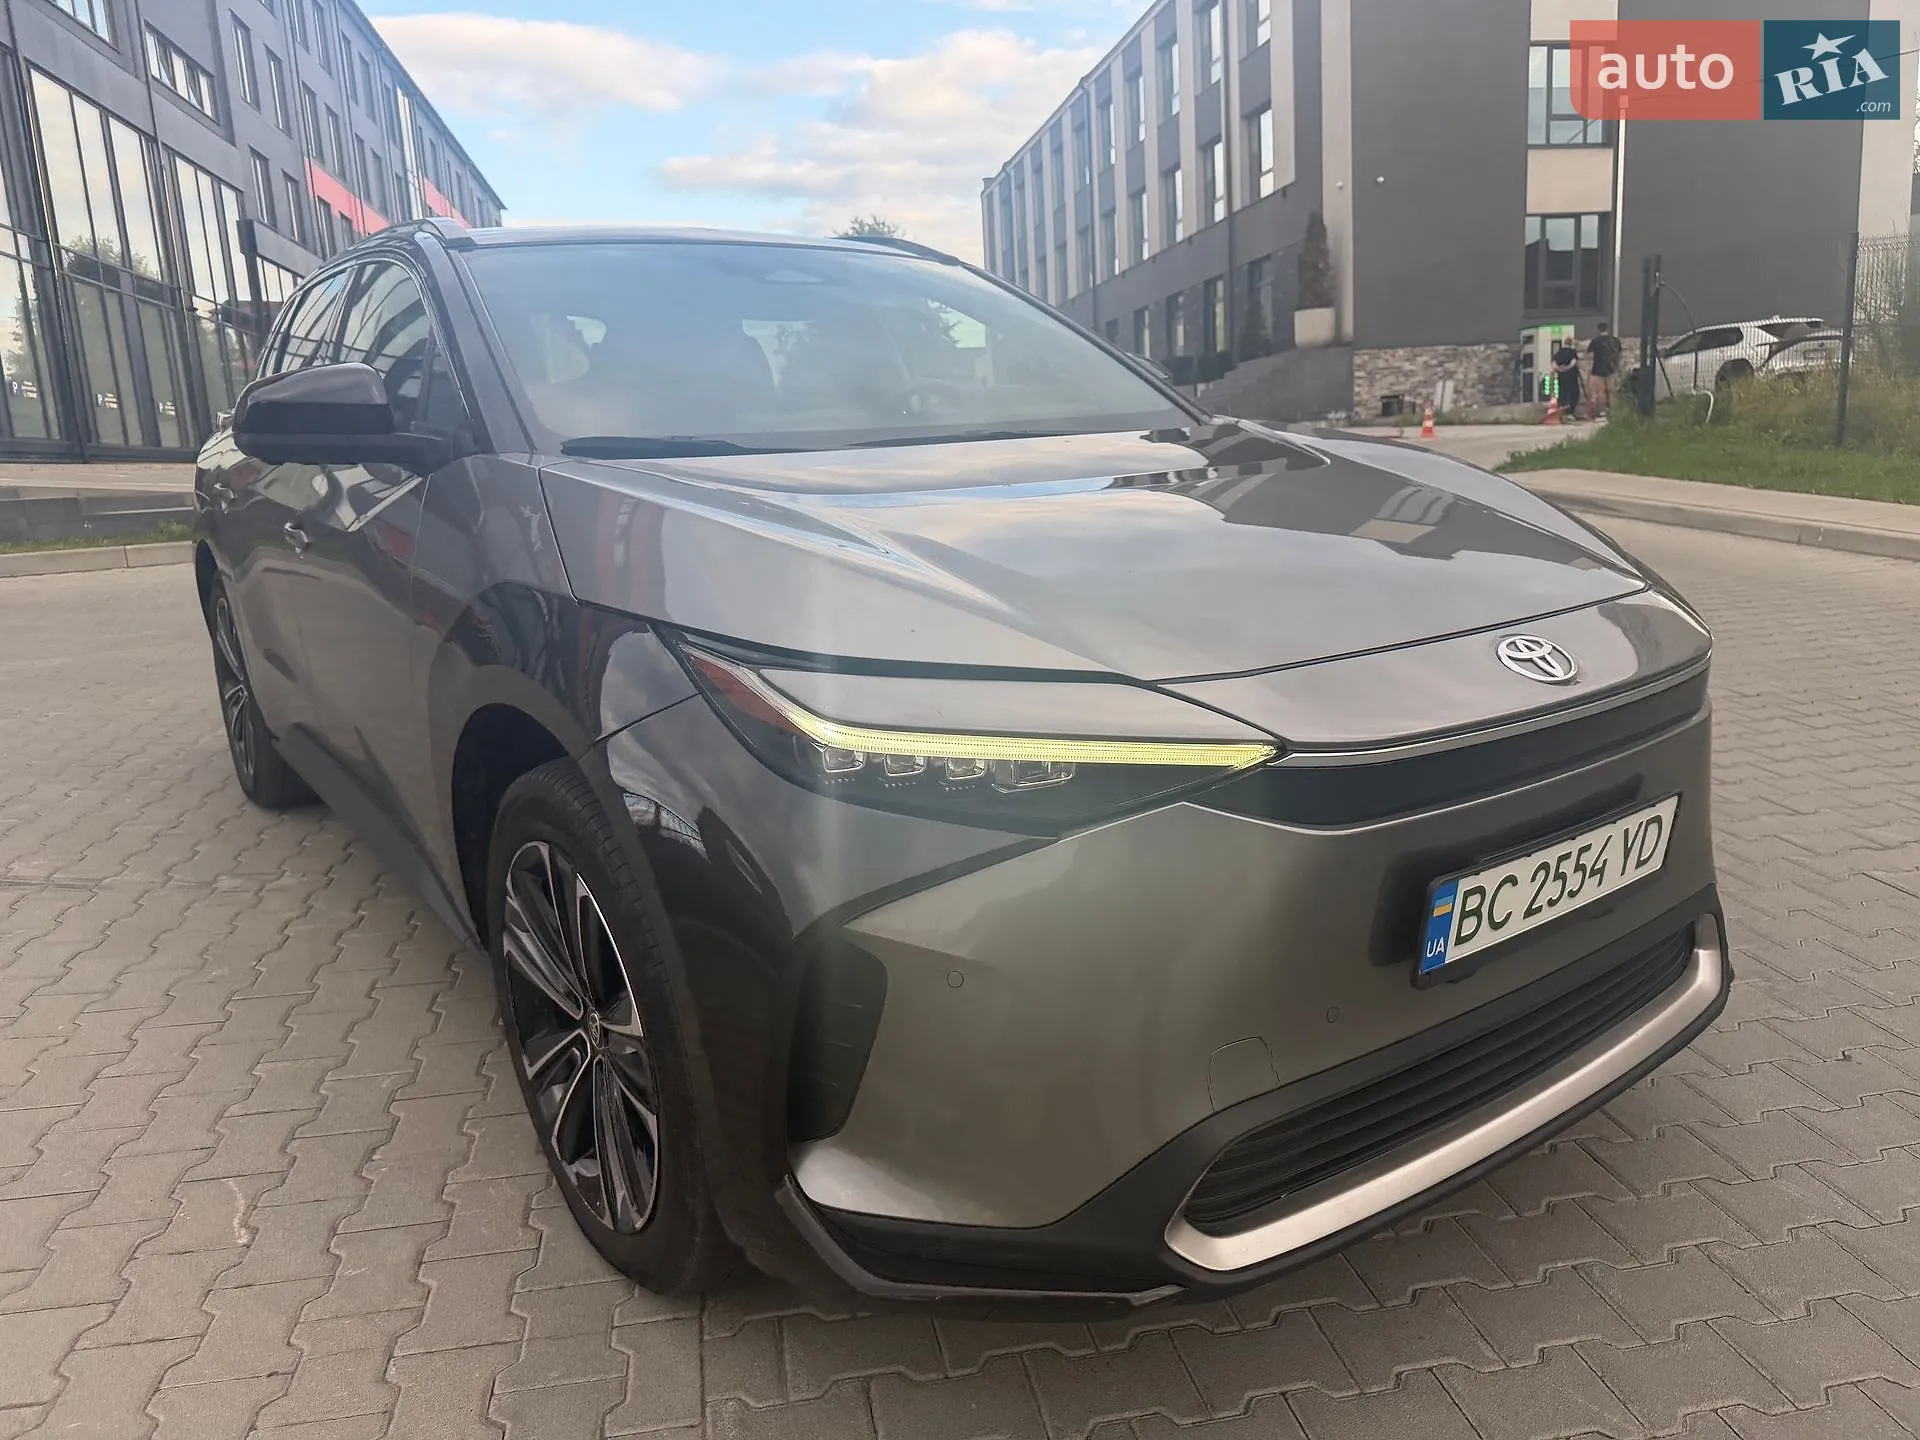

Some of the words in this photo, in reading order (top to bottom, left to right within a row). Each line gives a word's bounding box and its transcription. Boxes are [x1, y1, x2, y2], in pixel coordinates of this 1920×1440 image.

[1454, 874, 1518, 946] BC
[1522, 834, 1613, 920] 2554
[1620, 814, 1663, 876] YD
[1426, 936, 1445, 958] UA
